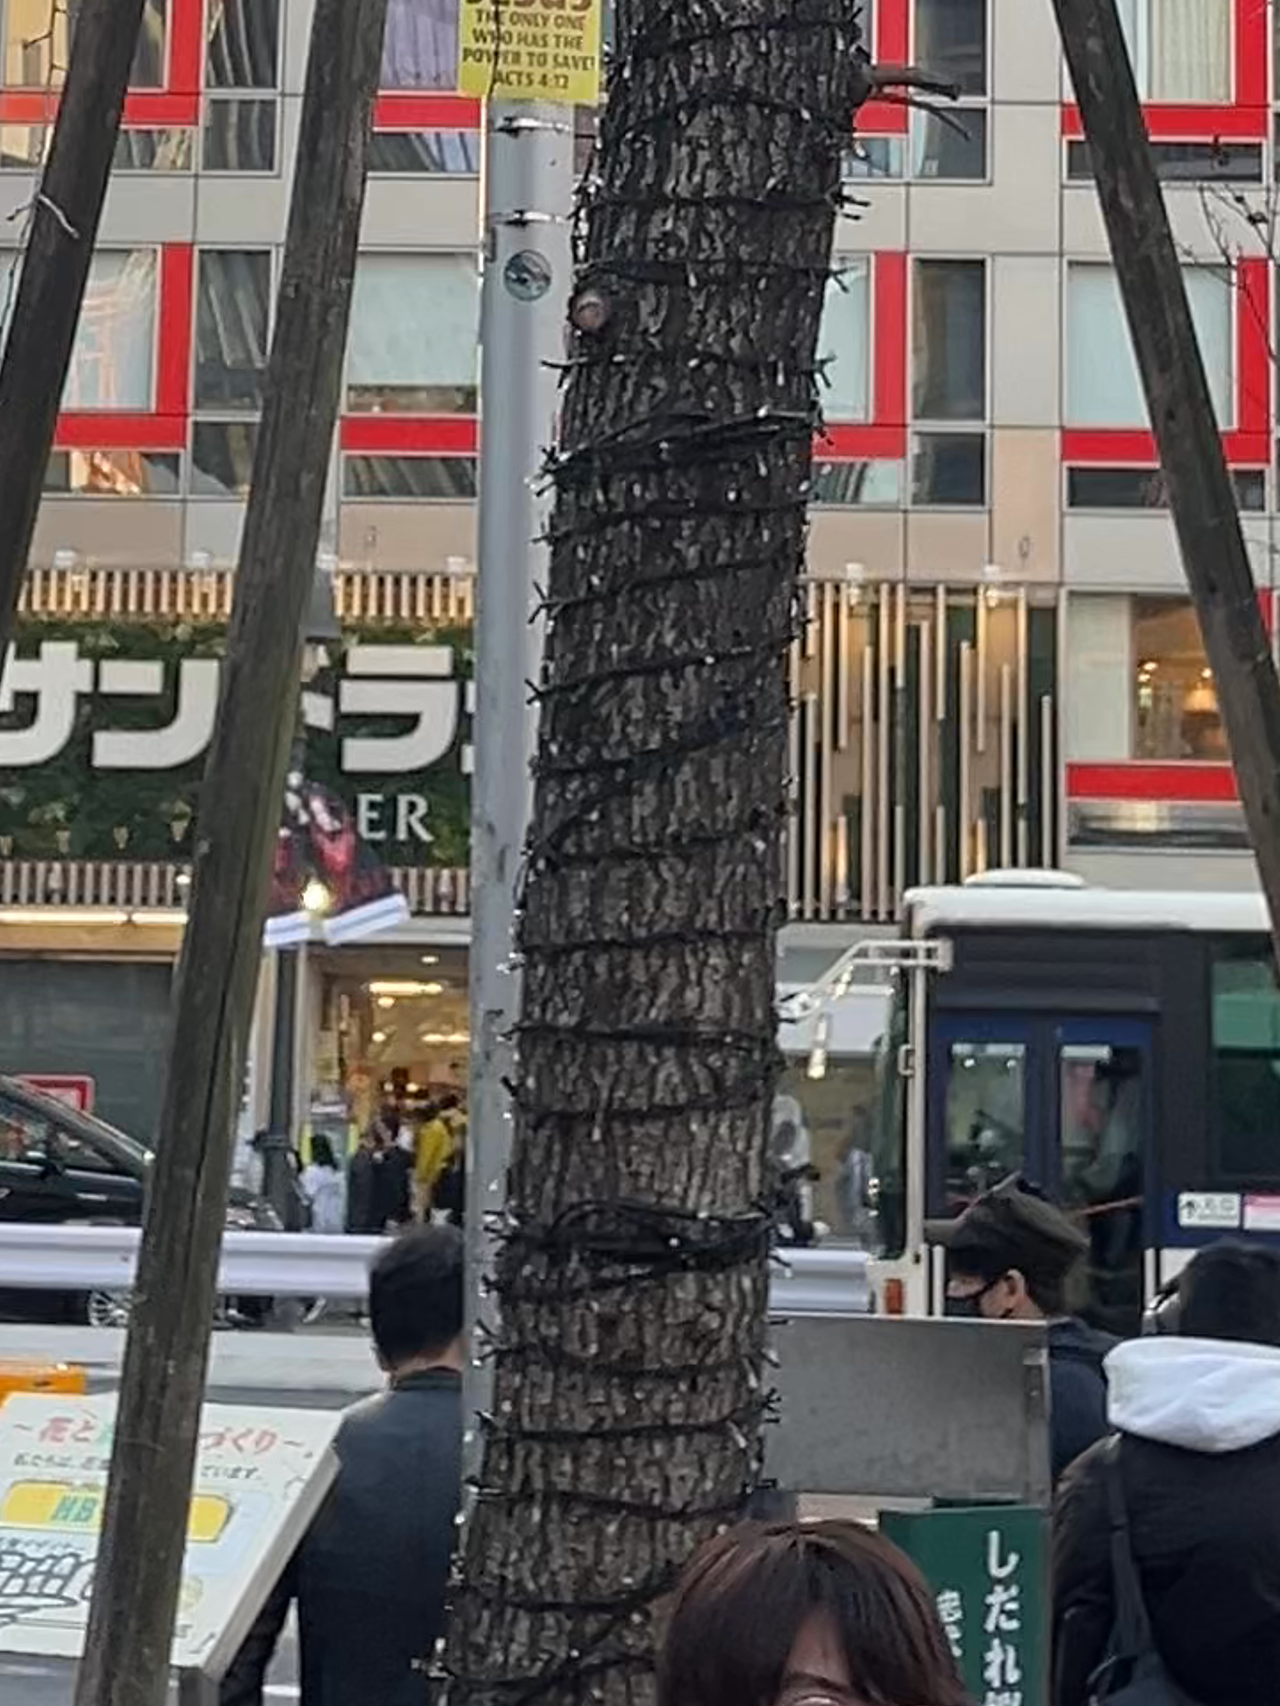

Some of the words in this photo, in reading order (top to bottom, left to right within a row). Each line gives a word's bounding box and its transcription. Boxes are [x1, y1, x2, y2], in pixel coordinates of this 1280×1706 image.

[509, 12, 549, 29] ONLY
[554, 15, 587, 31] ONE
[516, 32, 548, 48] HAS
[553, 34, 583, 50] THE
[525, 51, 548, 66] TO
